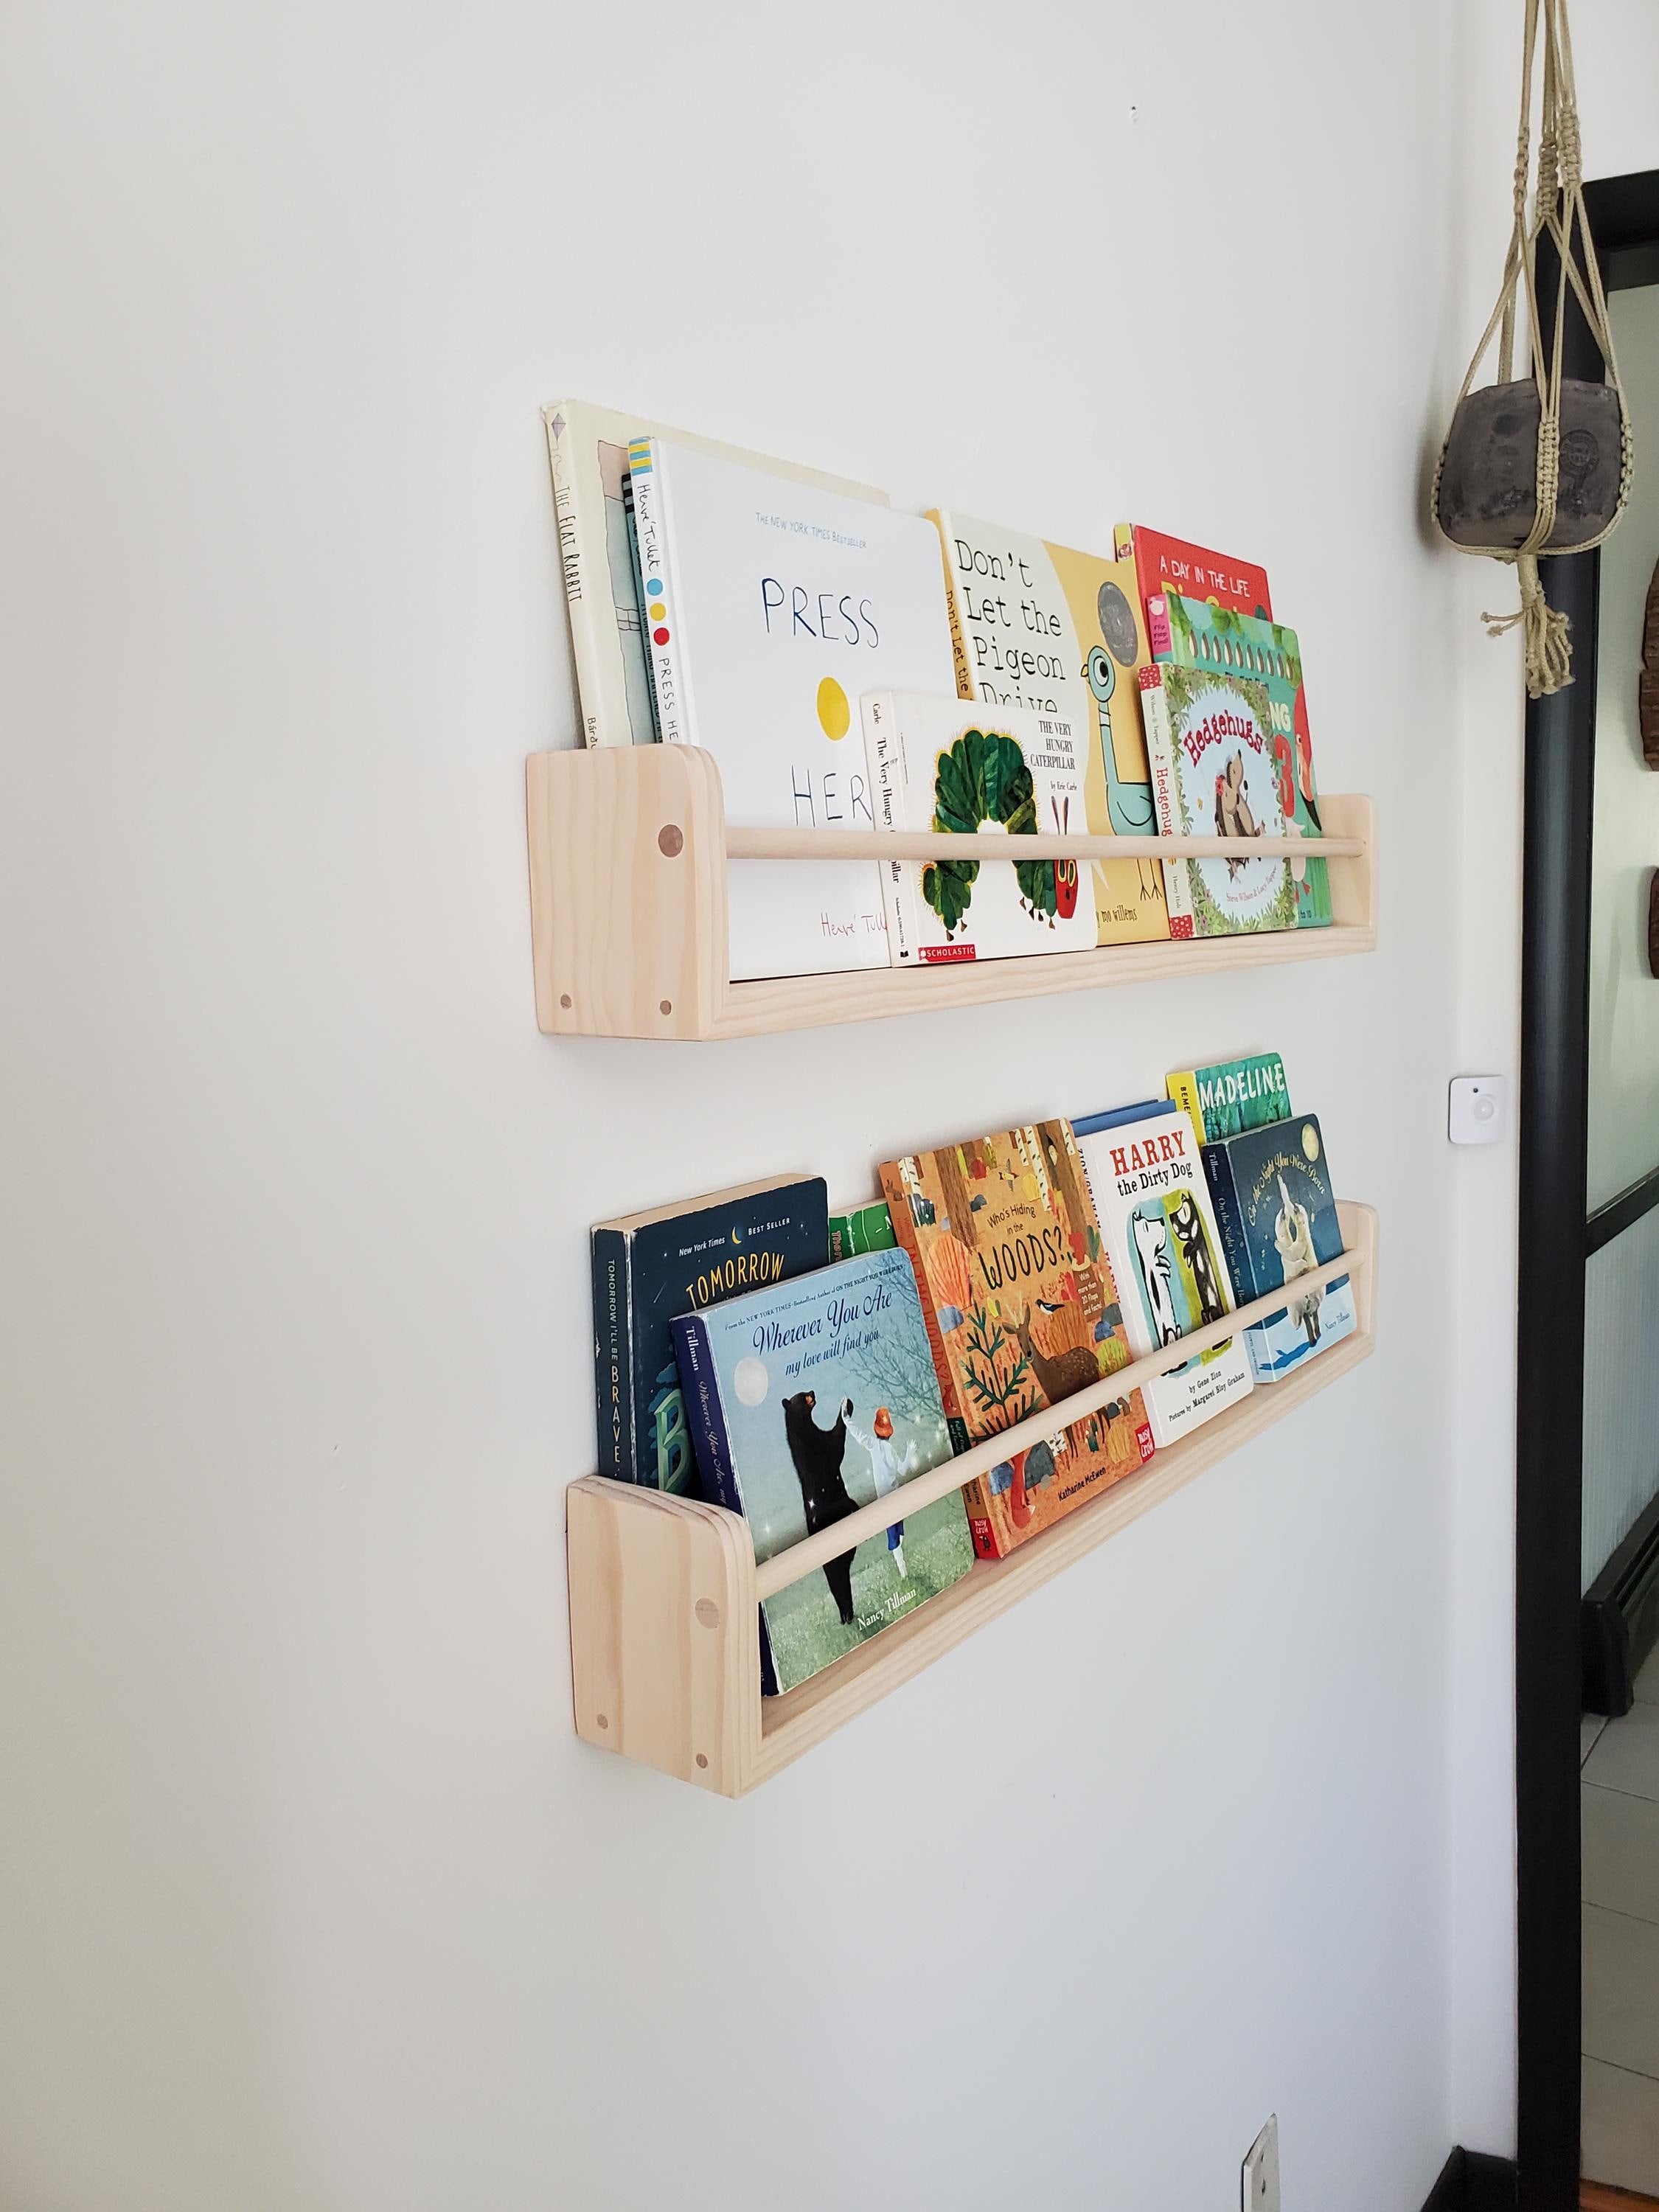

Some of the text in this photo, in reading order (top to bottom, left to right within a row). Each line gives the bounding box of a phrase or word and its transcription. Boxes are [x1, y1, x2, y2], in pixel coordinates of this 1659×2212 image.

[555, 486, 582, 602] THE FLAT RABBIT
[771, 517, 787, 530] NEW
[789, 521, 809, 535] YORK
[811, 526, 831, 540] TIMES
[954, 539, 1033, 588] Don't
[1160, 555, 1168, 574] A
[1171, 560, 1190, 580] DAY
[1194, 566, 1205, 583] IN
[1207, 570, 1228, 591] THE
[1230, 577, 1251, 598] LIFE
[762, 577, 879, 648] PRESS
[963, 586, 1062, 636] Let the
[952, 637, 964, 662] Let
[958, 668, 969, 692] the
[973, 636, 1066, 680] Pigeon
[658, 658, 678, 741] PRESS HE
[1038, 720, 1072, 736] THE VERY
[1046, 738, 1074, 753] HUNGRY
[1183, 709, 1264, 768] Hedgehugs
[872, 703, 893, 827] Carle The Very Hungry
[1030, 754, 1075, 770] CATERPILLAR
[791, 764, 872, 827] HER
[1050, 781, 1077, 791] by Eric Carle
[1156, 767, 1173, 837] Hedgehug
[1102, 911, 1112, 922] mo
[1113, 905, 1138, 922] willems
[926, 947, 975, 958] SCHOLASTIC
[1180, 1086, 1192, 1114] BEME
[1198, 1062, 1285, 1111] MADELINE
[1109, 1130, 1186, 1177] HARRY
[1208, 1152, 1219, 1182] Tillman
[1117, 1161, 1193, 1197] the Dirty Dog
[1252, 1186, 1262, 1205] the
[1259, 1158, 1275, 1189] Night
[1274, 1151, 1289, 1172] You
[1289, 1154, 1307, 1172] Were
[1307, 1165, 1326, 1194] Born
[987, 1203, 1037, 1228] Who's Hiding
[1218, 1197, 1226, 1211] On
[1220, 1212, 1229, 1225] the
[678, 1247, 692, 1257] New
[694, 1242, 706, 1253] York
[708, 1237, 726, 1248] Times
[1006, 1222, 1024, 1235] in the
[1224, 1226, 1236, 1248] Night
[978, 1225, 1065, 1290] WOODS?
[1227, 1248, 1237, 1267] You
[1231, 1267, 1241, 1288] Were
[686, 1252, 785, 1311] TOMORROW
[738, 1318, 746, 1326] the
[746, 1314, 759, 1325] NEW
[759, 1310, 775, 1319] YORK
[844, 1281, 854, 1290] THE
[853, 1276, 869, 1287] NIGHT
[869, 1273, 879, 1281] YOU
[753, 1284, 892, 1356] Wherever You Are
[608, 1259, 621, 1464] TOMORROW I'LL BE BRAVE
[785, 1329, 880, 1379] my love will find you
[686, 1326, 699, 1371] Tillman
[698, 1380, 712, 1427] Wherever
[706, 1430, 720, 1456] You
[1168, 1408, 1186, 1422] Pictures
[1186, 1405, 1192, 1413] by
[1192, 1391, 1215, 1408] Margaret
[1227, 1371, 1245, 1387] Graham
[1189, 1370, 1222, 1394] by Gene Zion
[1058, 1467, 1106, 1502] Katharine McEwen
[857, 1588, 917, 1631] Nancy Tillman
